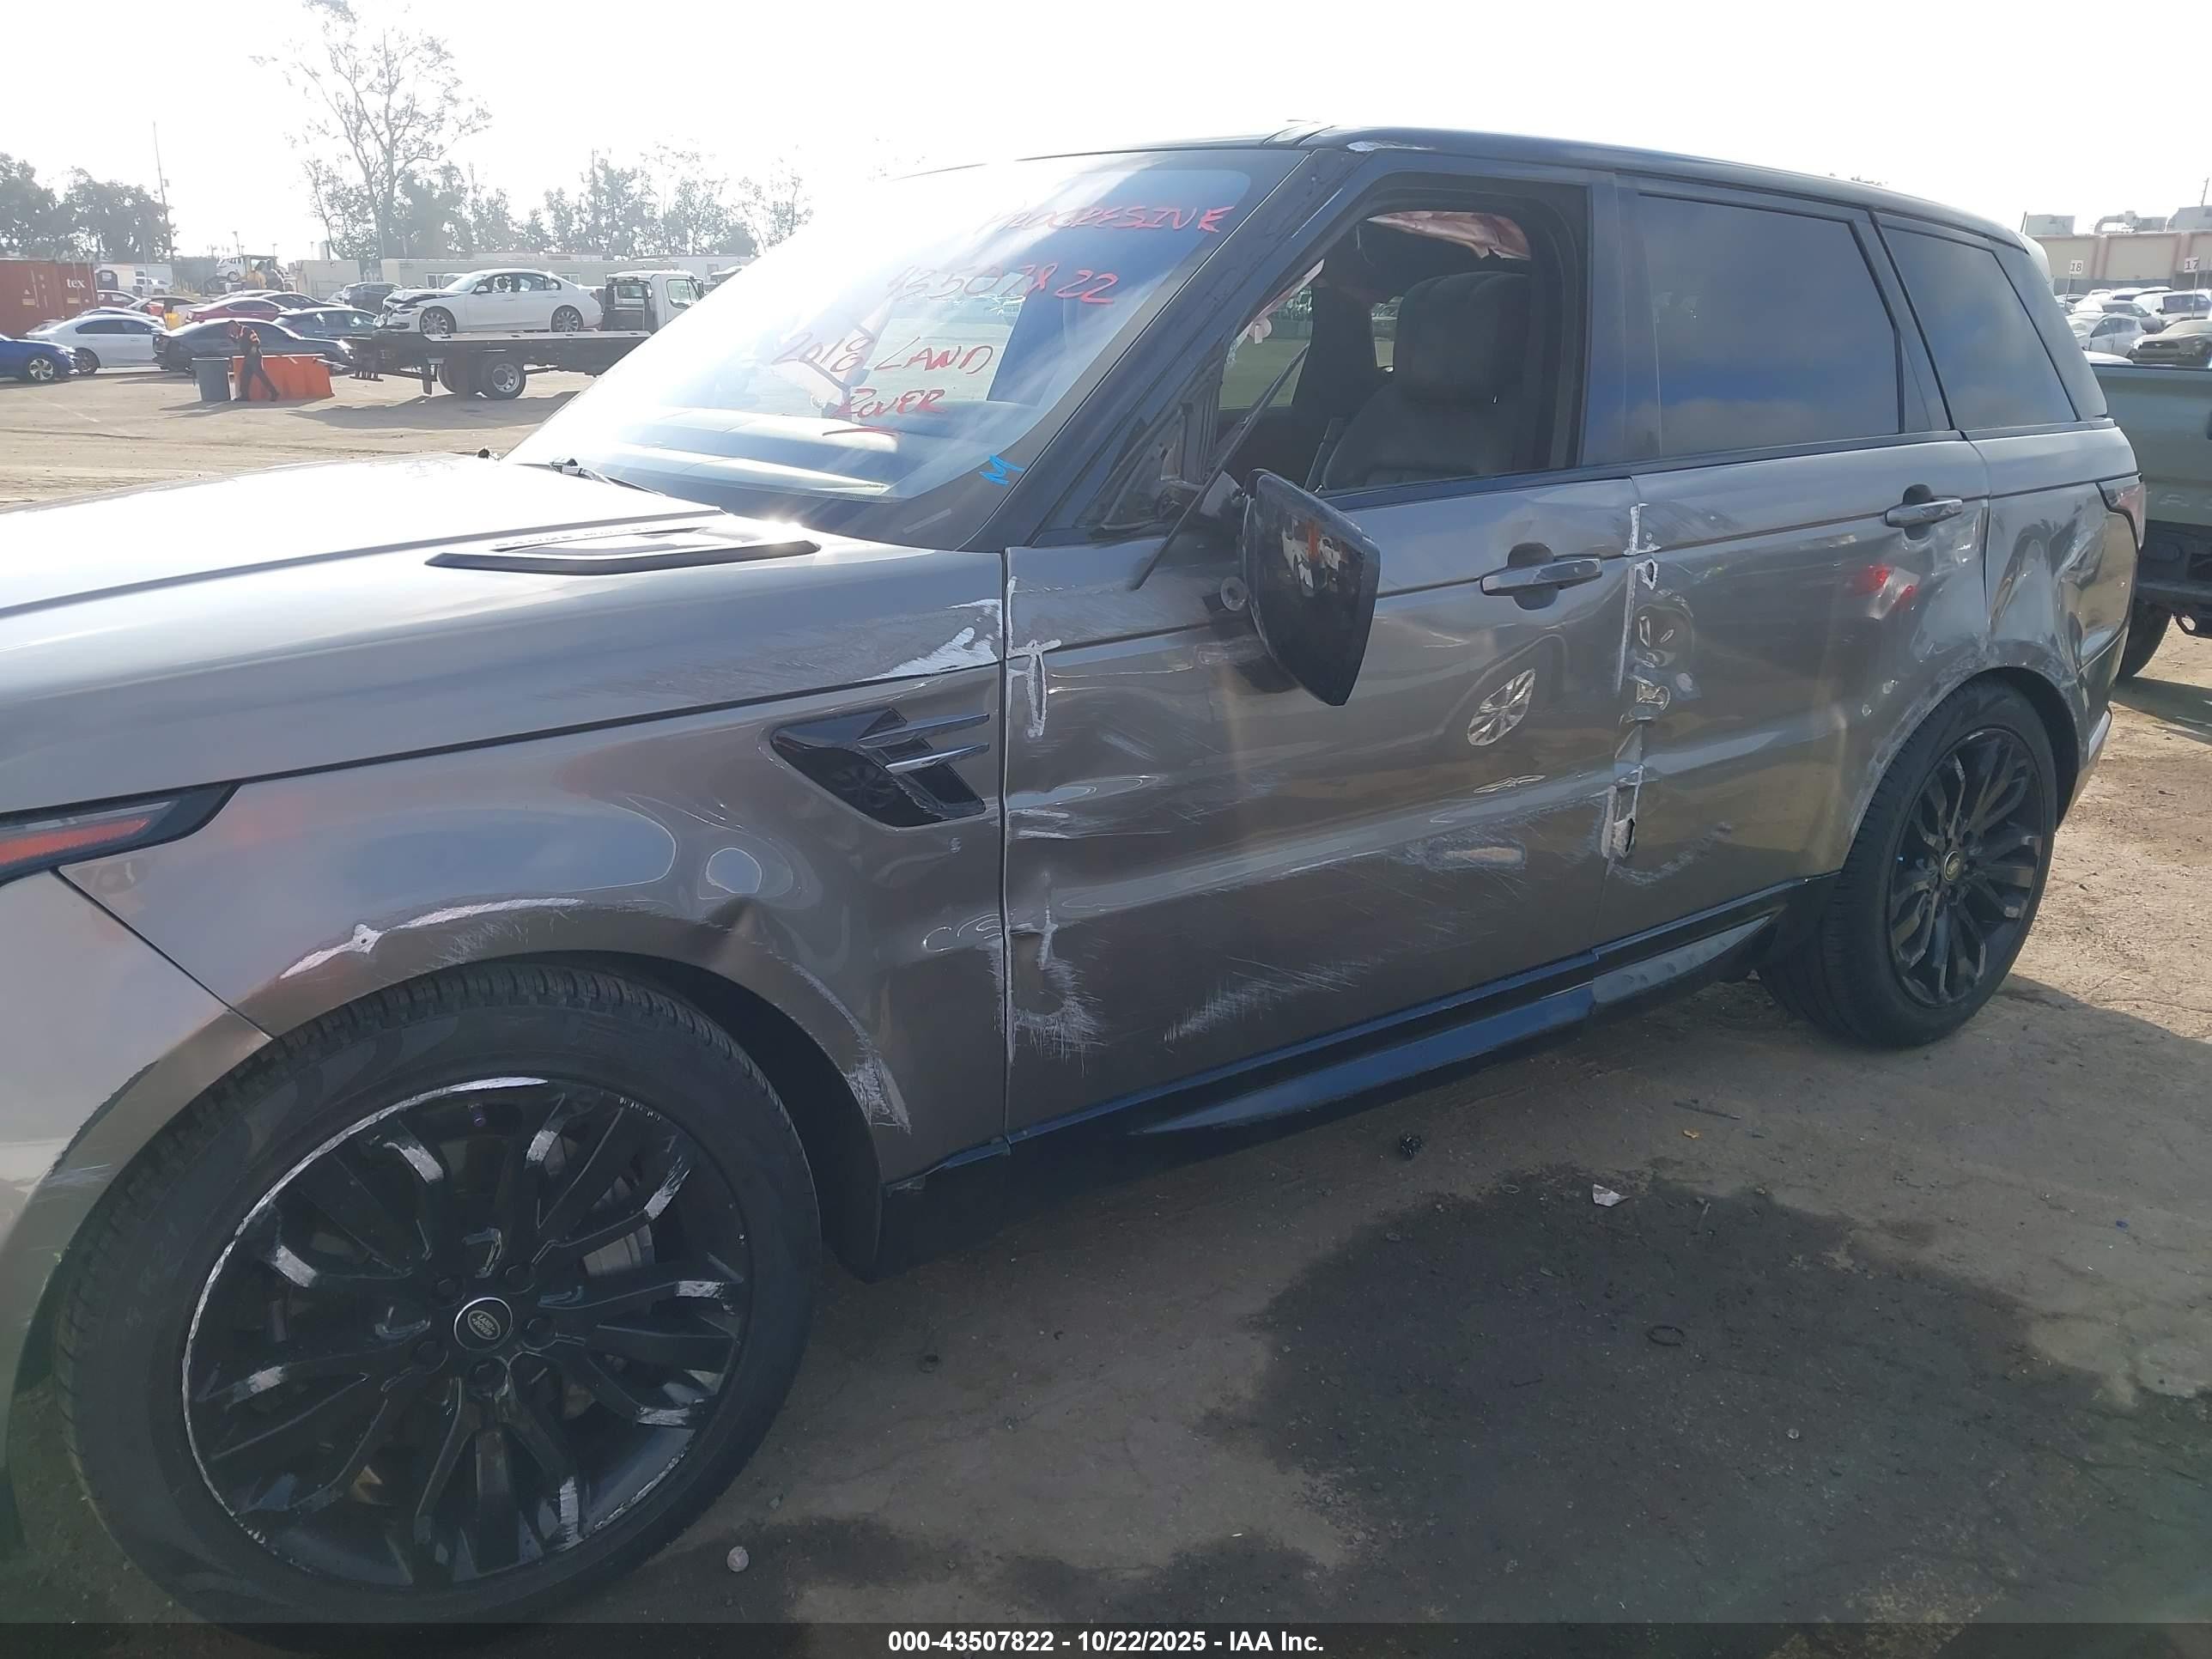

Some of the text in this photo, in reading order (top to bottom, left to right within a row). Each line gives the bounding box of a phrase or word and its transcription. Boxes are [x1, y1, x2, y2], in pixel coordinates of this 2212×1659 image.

[2070, 263, 2082, 272] 18
[2185, 259, 2199, 270] 17
[67, 278, 86, 289] tex
[771, 331, 994, 374] 2018 LAND
[831, 387, 949, 418] ROVER
